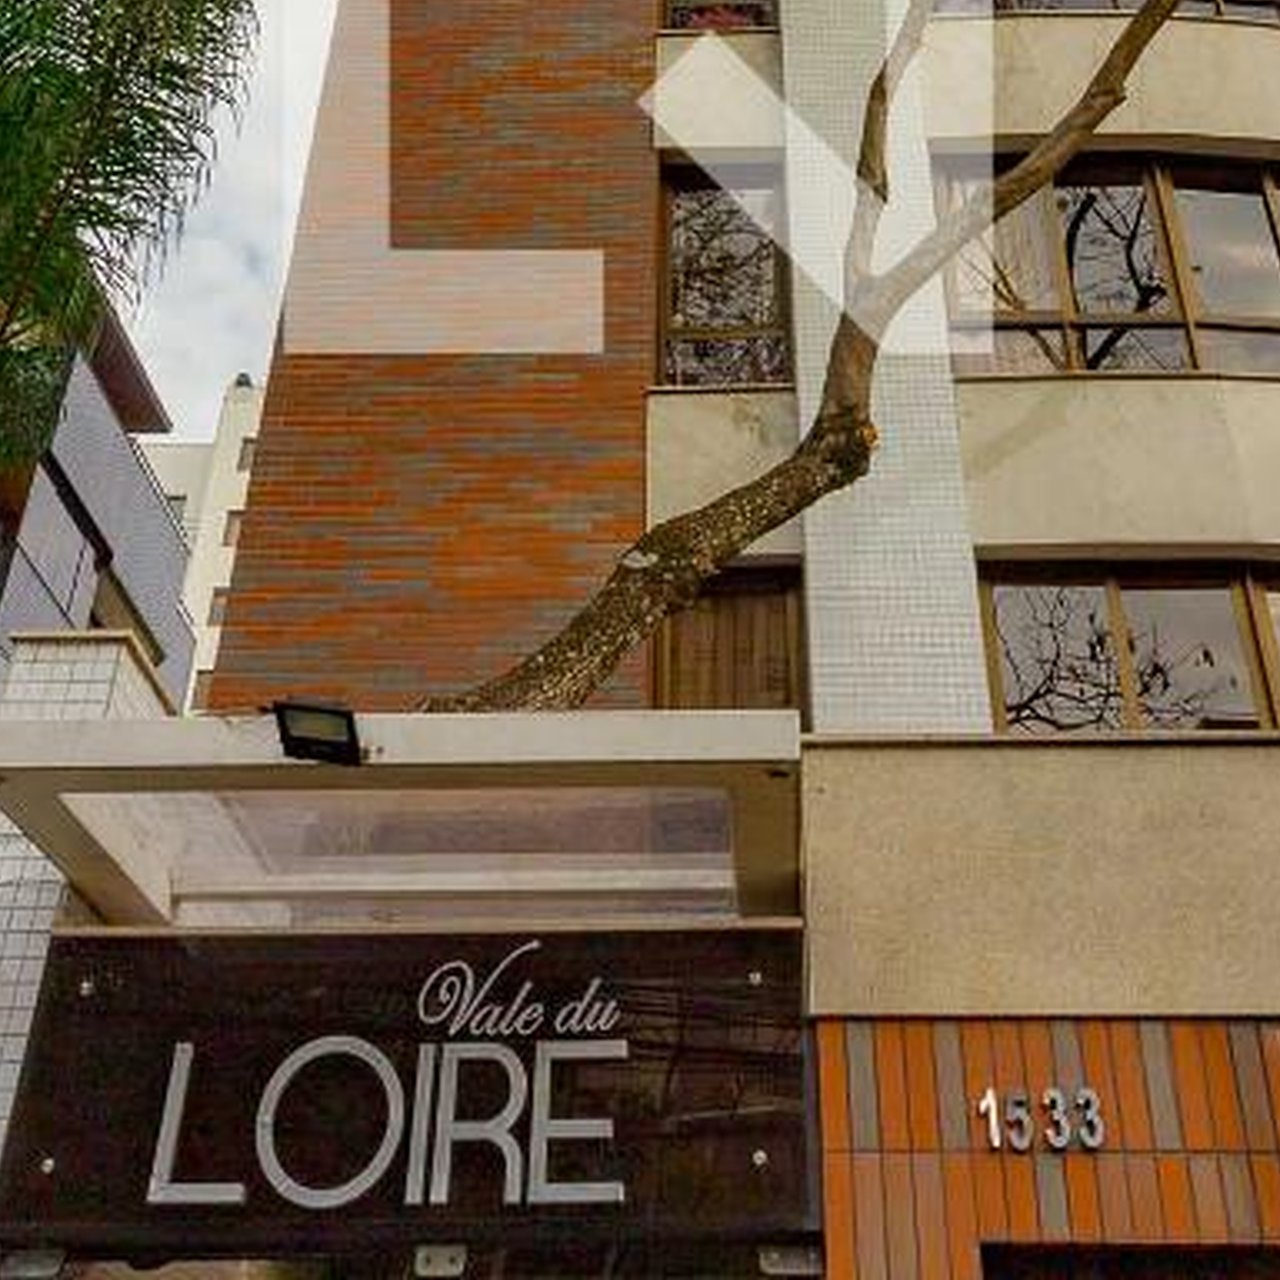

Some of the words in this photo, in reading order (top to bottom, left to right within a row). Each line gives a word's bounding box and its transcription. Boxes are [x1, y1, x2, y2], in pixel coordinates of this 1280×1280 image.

[419, 940, 544, 1036] Vale
[554, 977, 621, 1032] du
[146, 1034, 629, 1209] LOIRE
[978, 1086, 1105, 1151] 1533
